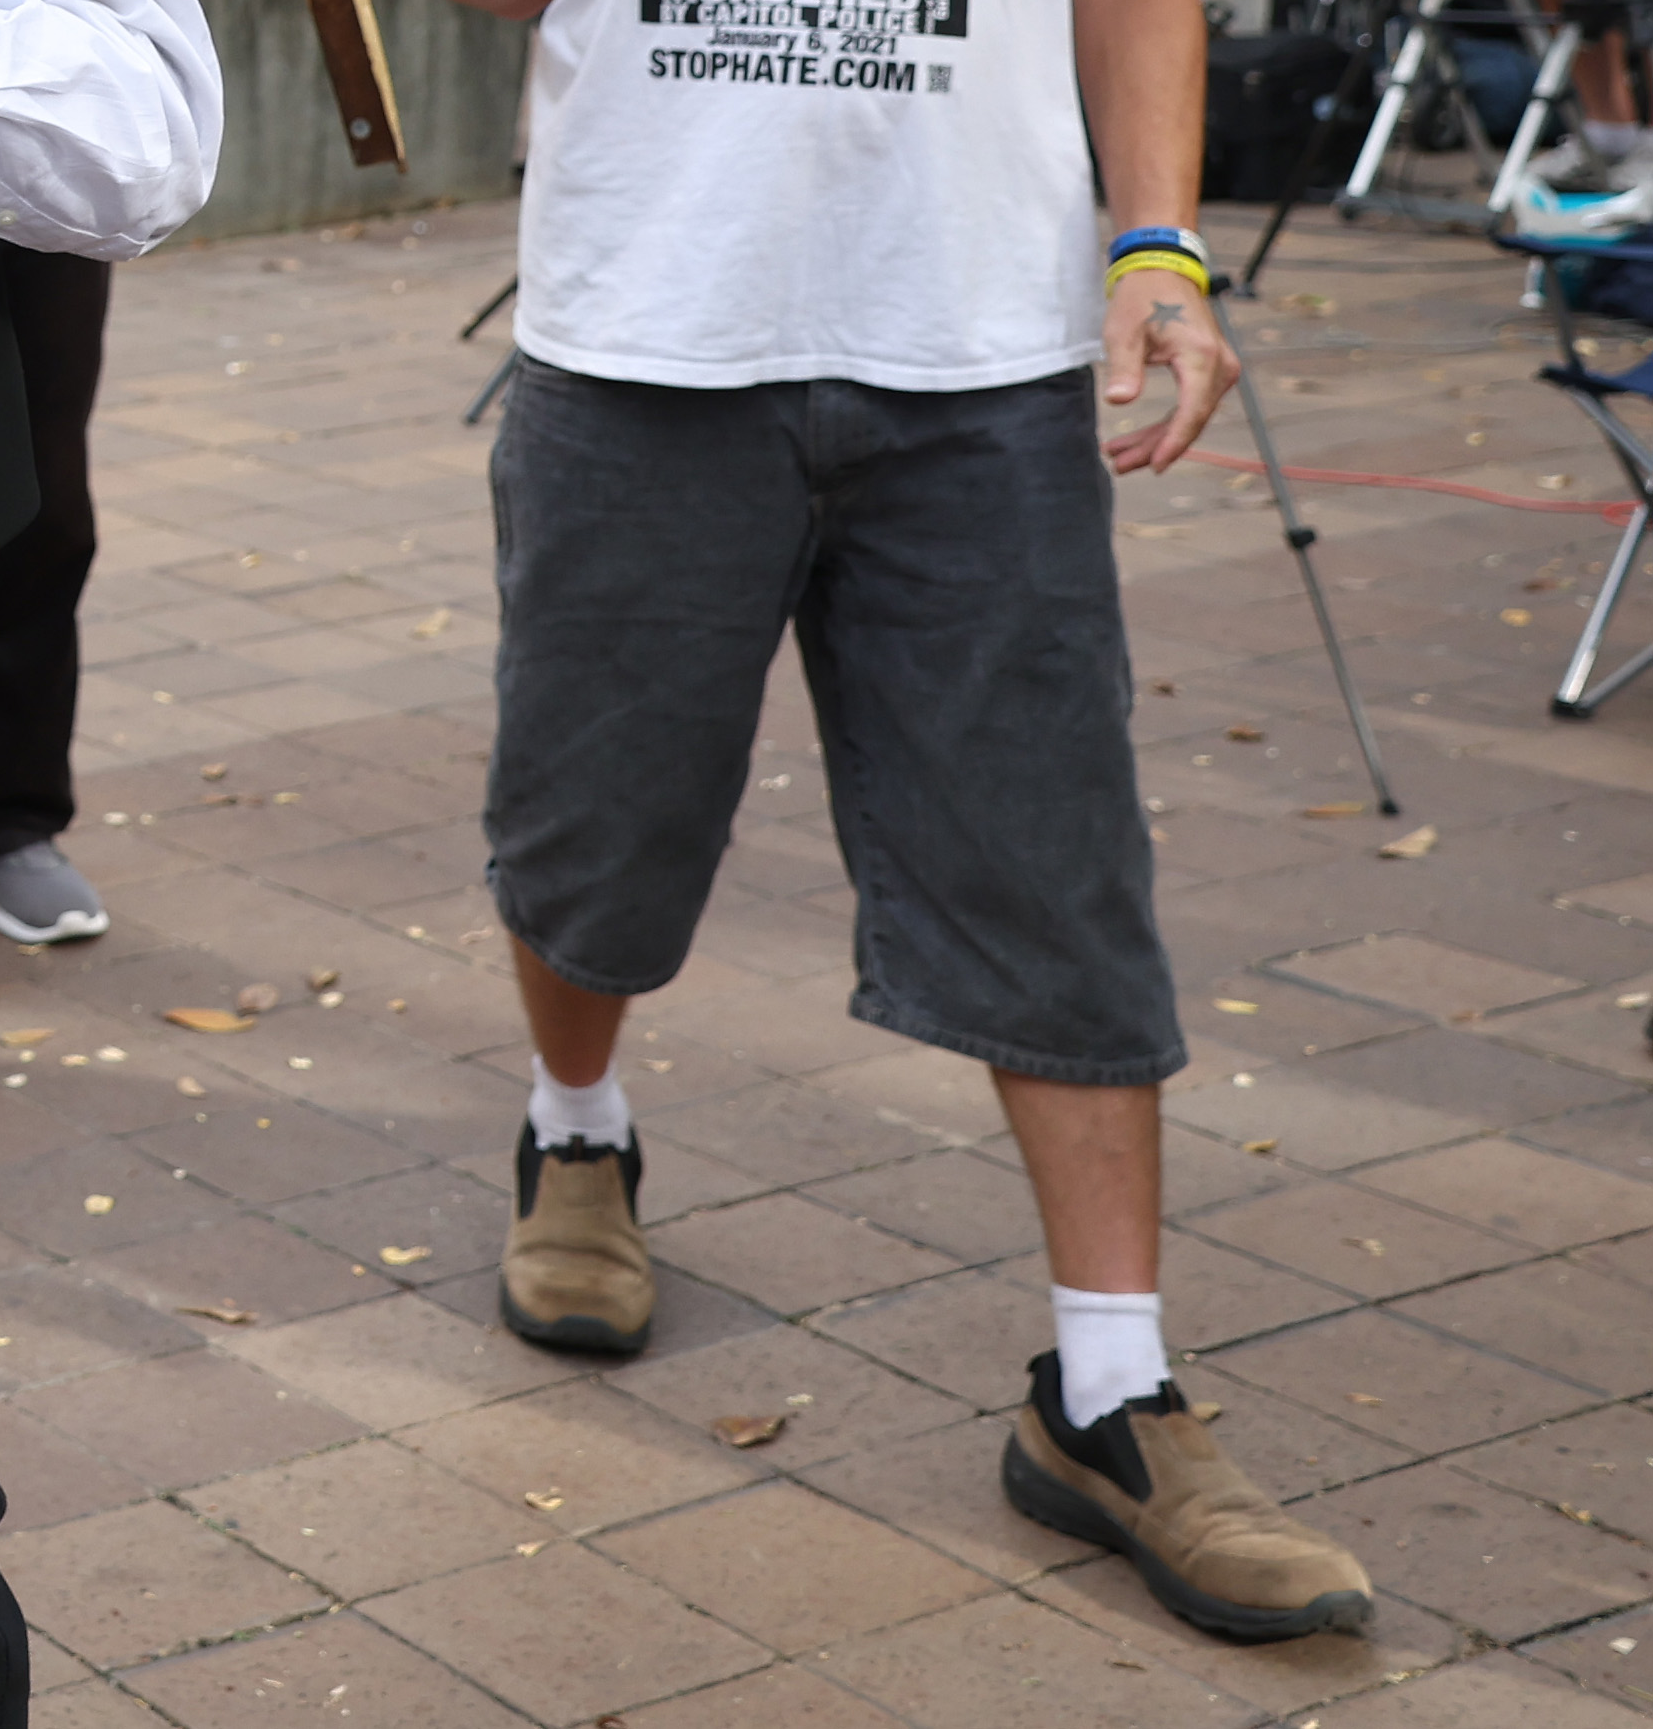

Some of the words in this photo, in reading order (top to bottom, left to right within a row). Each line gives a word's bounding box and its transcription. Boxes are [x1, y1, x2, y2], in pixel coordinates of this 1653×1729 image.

[660, 3, 689, 24] BY
[697, 3, 809, 27] CAPITOL
[817, 8, 920, 35] POLICE
[707, 27, 795, 53] January
[807, 31, 828, 53] 6,
[841, 33, 897, 56] 2021
[649, 48, 916, 92] STOPHATE.COM
